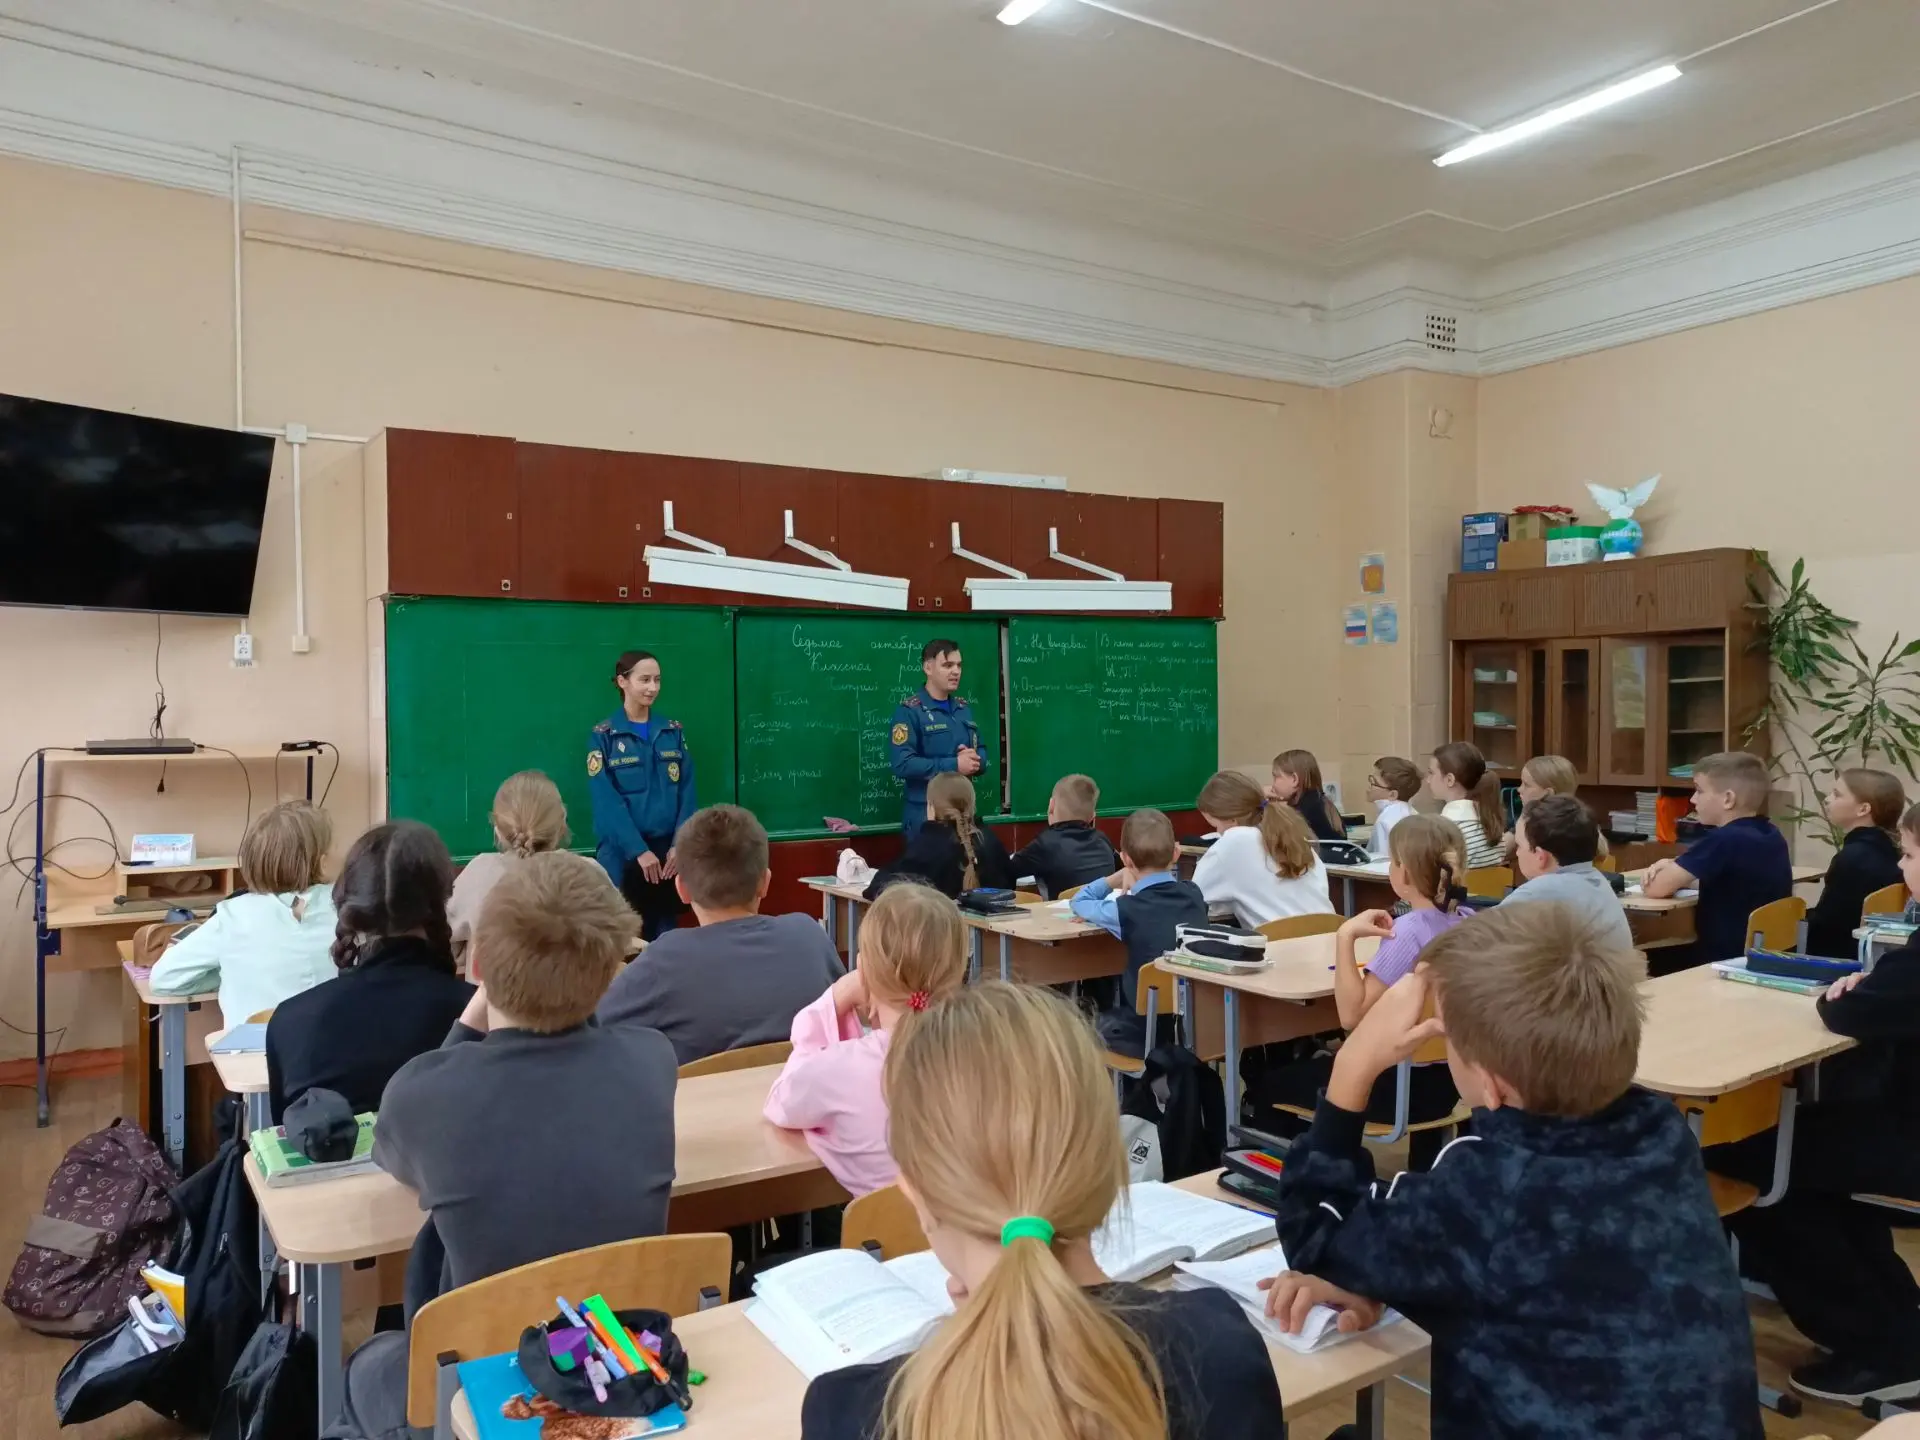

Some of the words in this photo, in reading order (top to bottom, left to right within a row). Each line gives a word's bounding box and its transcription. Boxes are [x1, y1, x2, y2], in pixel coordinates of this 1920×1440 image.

[792, 624, 843, 656] Седьмое
[870, 633, 925, 661] октября
[809, 652, 872, 672] Классная
[898, 656, 924, 683] раб
